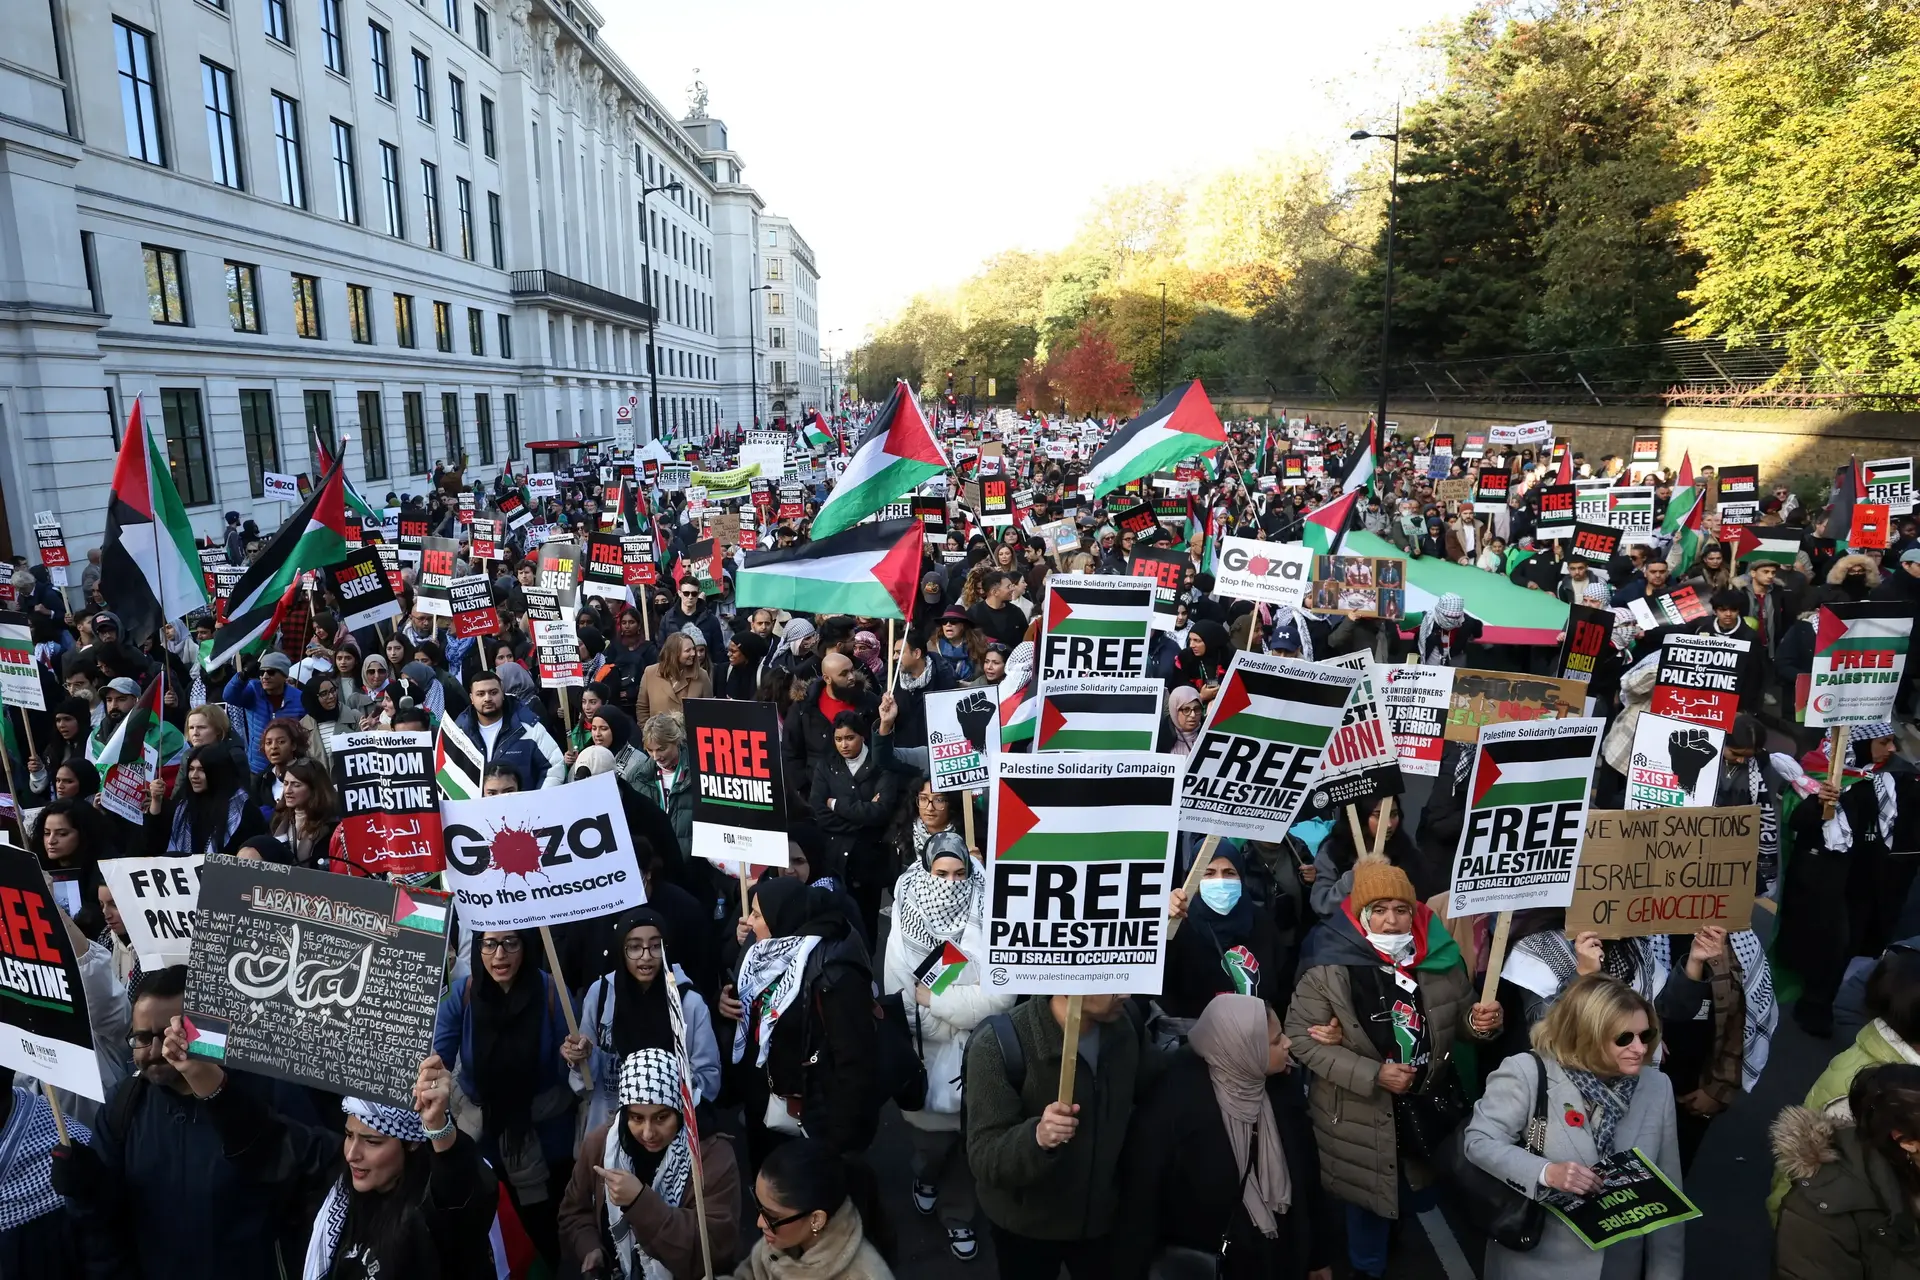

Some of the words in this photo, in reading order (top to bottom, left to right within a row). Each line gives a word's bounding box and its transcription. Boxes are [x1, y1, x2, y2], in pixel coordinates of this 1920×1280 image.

[1435, 438, 1452, 446] FREE
[660, 472, 677, 482] FREE
[1481, 475, 1508, 489] FREE
[985, 481, 1005, 497] END
[1480, 488, 1506, 496] PALESTINE
[985, 496, 1005, 504] ISRAELI
[1541, 493, 1572, 511] FREE
[1541, 509, 1573, 519] PALESTINE
[1608, 511, 1651, 526] FREE
[37, 529, 60, 539] FREEDOM
[401, 521, 429, 536] FREE
[39, 539, 64, 548] PALESTINE
[623, 543, 650, 551] FREEDOM
[1576, 531, 1617, 553] FREE
[423, 549, 453, 575] FREE
[623, 555, 652, 563] PALESTINE
[1572, 546, 1611, 561] PALESTINE
[335, 567, 358, 584] END
[354, 560, 376, 577] THE
[559, 558, 573, 573] THE
[590, 562, 623, 575] PALESTINE
[1133, 558, 1180, 588] FREE
[1223, 548, 1303, 581] Gza
[340, 573, 382, 600] SIEGE
[541, 571, 572, 590] SIEGE
[1051, 578, 1082, 586] Palestine
[1084, 579, 1115, 589] Solidarity
[1117, 581, 1152, 589] Campaign
[1220, 576, 1239, 587] Stop
[1241, 579, 1255, 588] the
[1256, 583, 1299, 595] massacre
[451, 583, 486, 598] FREEDOM
[453, 597, 492, 613] PALESTINE
[527, 596, 555, 606] FREEDOM
[1670, 585, 1708, 623] FREE
[1571, 620, 1605, 656] END
[1676, 636, 1709, 645] Socialist
[1709, 640, 1736, 648] Worker
[541, 655, 557, 663] STATE
[558, 654, 579, 663] TERROR
[542, 646, 552, 654] END
[554, 646, 576, 654] ISRAELI
[1044, 636, 1145, 671] FREE
[1667, 647, 1738, 668] FREEDOM
[1567, 652, 1596, 672] ISRAELI
[1694, 664, 1708, 673] for
[1830, 650, 1896, 672] FREE
[1238, 658, 1276, 673] Palestine
[1278, 664, 1318, 681] Solidarity
[1318, 671, 1356, 686] Campaign
[1398, 669, 1436, 677] Socialist
[1660, 668, 1738, 692] PALESTINE
[1816, 671, 1900, 686] PALESTINE
[1046, 684, 1078, 693] Palestine
[1081, 683, 1117, 694] Solidarity
[1120, 684, 1158, 694] Campaign
[1412, 688, 1446, 697] WORKERS'
[1387, 695, 1415, 703] STRUGGLE
[1668, 692, 1719, 707] الحرية
[1396, 707, 1437, 722] ISRAELI
[1660, 707, 1723, 724] لفلسطين
[1400, 721, 1442, 736] TERROR
[1483, 728, 1516, 741] Palestine
[1518, 726, 1557, 738] Solidarity
[1558, 725, 1598, 736] Campaign
[381, 736, 417, 746] Worker
[932, 742, 972, 758] EXIST.
[1394, 737, 1432, 747] SOCIALIST
[696, 726, 770, 778] FREE
[344, 752, 424, 777] FREEDOM
[935, 755, 980, 773] RESIST.
[1000, 762, 1054, 775] Palestine
[1058, 763, 1113, 775] Solidarity
[1116, 763, 1175, 776] Campaign
[1189, 732, 1322, 791] FREE
[938, 768, 988, 788] RETURN.
[1330, 777, 1372, 792] PALESTINE
[1633, 769, 1678, 788] EXIST.
[700, 774, 774, 804] PALESTINE
[1182, 774, 1301, 810] PALESTINE
[1330, 782, 1378, 798] SOLIDARITY
[1332, 789, 1374, 802] CAMPAIGN
[1632, 785, 1684, 805] RESIST.
[344, 786, 433, 812] PALESTINE
[1197, 800, 1232, 814] ISRAELI
[1233, 806, 1290, 822] OCCUPATION
[366, 818, 421, 838] الحرية
[1186, 814, 1264, 832] www.palestinecampaign.org
[1462, 802, 1583, 857] FREE
[1584, 819, 1612, 840] WE
[1619, 820, 1660, 840] WANT
[1663, 815, 1750, 838] SANCTIONS
[444, 813, 618, 876] Gza
[723, 831, 735, 845] FOA
[362, 840, 432, 864] لفلسطين
[1646, 840, 1691, 860] NOW
[206, 853, 236, 866] GLOBAL
[238, 858, 259, 869] PEACE
[261, 860, 291, 875] JOURNEY
[1457, 849, 1574, 878] PALESTINE
[1457, 881, 1475, 892] END
[1476, 876, 1512, 890] ISRAELI
[1514, 872, 1568, 887] OCCUPATION
[1576, 863, 1662, 891] ISRAEL
[1664, 868, 1674, 887] is
[1679, 860, 1753, 890] GUILTY
[458, 888, 493, 908] Stop
[496, 884, 527, 904] the
[532, 870, 627, 897] massacre
[992, 862, 1165, 920] FREE
[1470, 890, 1548, 904] www.palestinecampaign.org
[254, 889, 309, 916] LABAIK
[314, 901, 332, 921] YA
[336, 904, 387, 934] HUSSEIN
[471, 918, 484, 928] Stop
[485, 919, 495, 927] the
[496, 917, 511, 926] War
[513, 914, 546, 925] Coalition
[550, 898, 625, 920] www.stopwar.org.uk
[1593, 899, 1621, 925] OF
[1627, 895, 1729, 922] GENOCIDE
[0, 886, 62, 964] EE
[144, 909, 199, 940] PALES
[213, 913, 236, 924] WANT
[253, 919, 271, 929] END
[990, 921, 1159, 948] PALESTINE
[379, 947, 404, 959] STOP
[406, 950, 426, 961] THE
[990, 951, 1018, 963] END
[1022, 952, 1072, 964] ISRAELI
[1076, 951, 1155, 963] OCCUPATION
[396, 961, 422, 972] STOP
[425, 966, 441, 976] THE
[993, 972, 1007, 981] PSC
[1016, 971, 1129, 982] www.palestinecampaign.org
[0, 956, 73, 1002] LESTINE
[923, 972, 937, 986] FOA
[199, 1003, 226, 1017] STAND
[229, 1011, 246, 1023] FOR
[21, 1038, 36, 1057] FOA
[386, 1034, 428, 1050] GENOCIDE
[294, 1064, 325, 1080] BRINGS
[343, 1077, 384, 1096] TOGETHER
[1597, 1188, 1640, 1210] NOW!
[1598, 1201, 1668, 1232] CEASEFIRE
